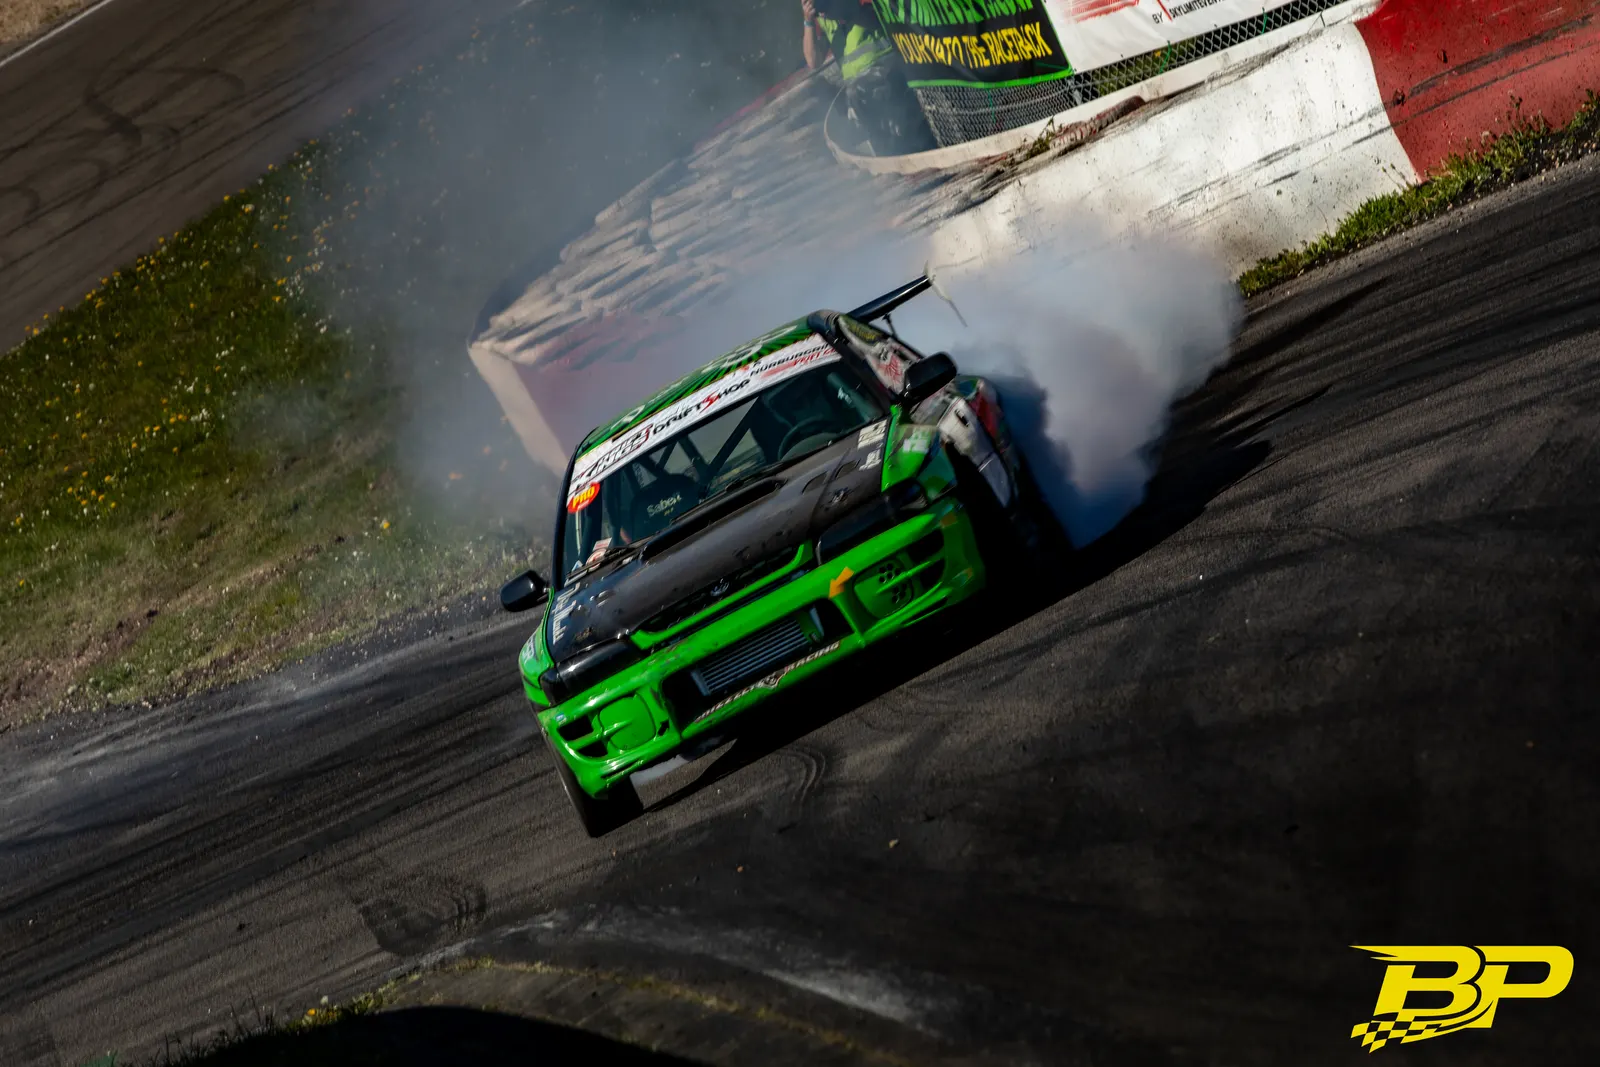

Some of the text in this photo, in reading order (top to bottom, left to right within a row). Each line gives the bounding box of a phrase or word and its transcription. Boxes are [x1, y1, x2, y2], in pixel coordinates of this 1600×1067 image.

[1152, 12, 1164, 24] BY
[961, 34, 991, 69] THE
[979, 21, 1053, 66] RACETRACK
[571, 485, 596, 509] PRO
[784, 641, 840, 672] RACING
